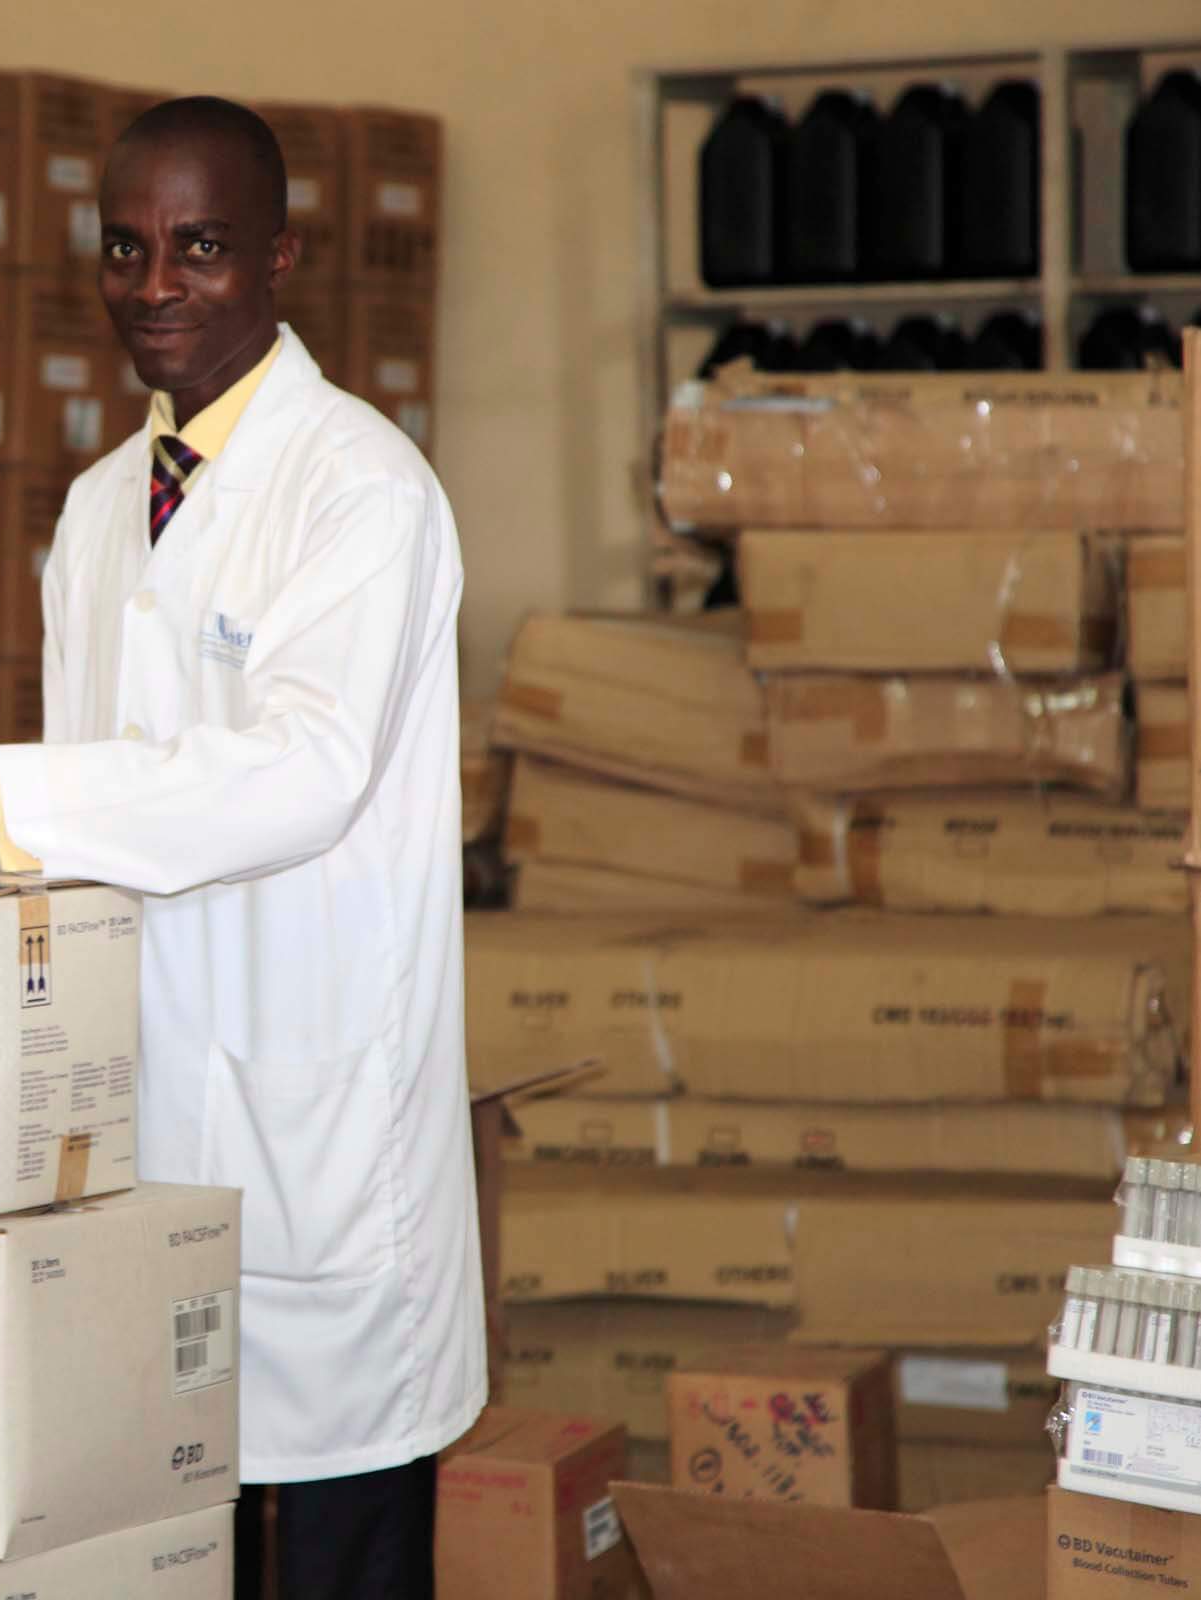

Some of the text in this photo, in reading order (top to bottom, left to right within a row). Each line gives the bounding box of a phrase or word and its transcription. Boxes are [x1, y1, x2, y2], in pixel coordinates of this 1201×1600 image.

[611, 989, 684, 1010] OTHRS
[168, 1231, 181, 1248] BD
[716, 1265, 791, 1283] OTHERS
[186, 1443, 204, 1465] BD
[1072, 1537, 1093, 1553] BD
[1072, 1556, 1189, 1589] Blood Collection Tubes
